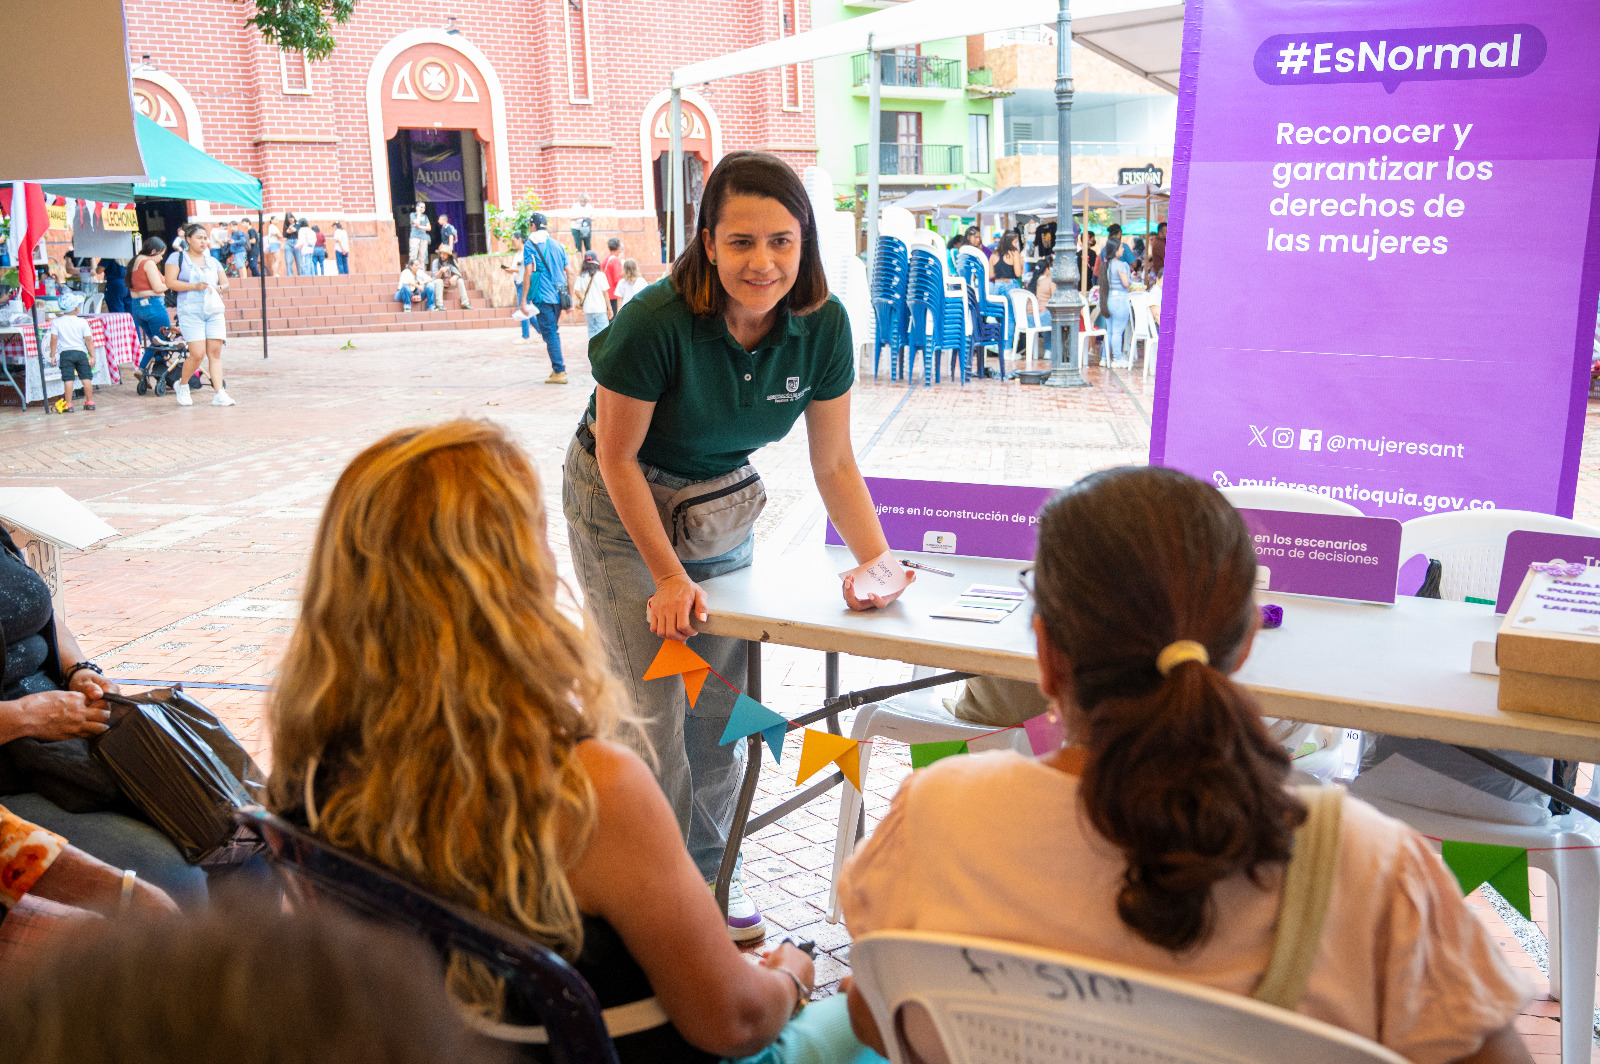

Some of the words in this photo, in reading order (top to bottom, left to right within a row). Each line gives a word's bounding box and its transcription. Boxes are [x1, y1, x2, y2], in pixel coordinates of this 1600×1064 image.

[1276, 33, 1522, 75] #EsNormal
[1276, 122, 1445, 145] Reconocer
[1453, 123, 1474, 151] y
[415, 167, 461, 187] Ayuno
[1121, 167, 1161, 185] FUSIÓN
[1272, 156, 1439, 189] garantizar
[1446, 156, 1494, 181] los
[1269, 193, 1415, 218] derechos
[1423, 193, 1466, 218] de
[108, 211, 138, 227] LECHONA
[1266, 228, 1311, 252] las
[1318, 228, 1449, 261] mujeres
[1326, 434, 1466, 459] @mujeresant
[875, 503, 905, 516] jeres
[906, 507, 921, 516] en
[923, 507, 934, 517] la
[935, 509, 1009, 523] construcción
[1011, 513, 1026, 524] de
[1253, 534, 1271, 544] en
[1273, 533, 1292, 546] los
[1294, 537, 1368, 552] escenarios
[1252, 545, 1285, 557] oma
[1288, 547, 1305, 559] de
[1308, 549, 1379, 566] decisiones
